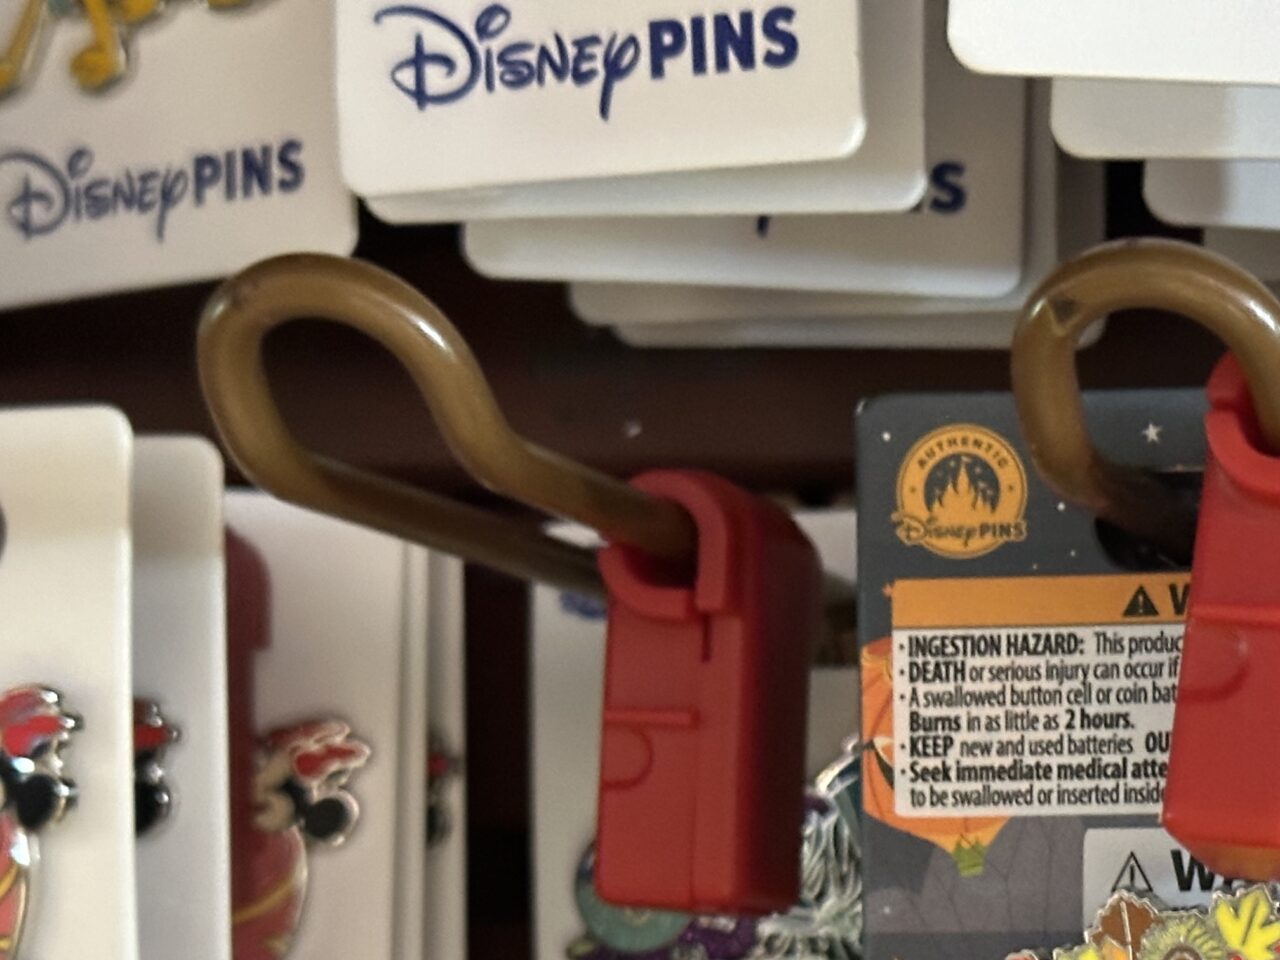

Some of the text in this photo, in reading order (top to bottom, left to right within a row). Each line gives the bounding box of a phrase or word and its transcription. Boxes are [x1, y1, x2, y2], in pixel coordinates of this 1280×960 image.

[648, 7, 800, 80] PINS
[193, 139, 305, 207] PINS
[917, 436, 1008, 470] AUTHENTIC
[908, 630, 1183, 659] INGESTION HAZARD: This produc
[909, 656, 1180, 686] DEATH or serious injury can occur if
[909, 687, 920, 708] A
[923, 684, 1006, 708] swallowed
[1010, 684, 1062, 707] button
[1066, 682, 1092, 704] cell
[1096, 687, 1113, 704] or
[1116, 682, 1148, 704] coin
[909, 706, 1135, 733] Burns in as little as 2 hours.
[909, 730, 1170, 757] KEEP new and used batteries OU
[909, 760, 951, 783] Seek
[956, 757, 1052, 782] immediate
[1057, 756, 1127, 780] medical
[911, 787, 926, 807] to
[930, 784, 949, 807] be
[951, 783, 1034, 808] swallowed
[1037, 787, 1053, 806] or
[1057, 781, 1120, 806] inserted
